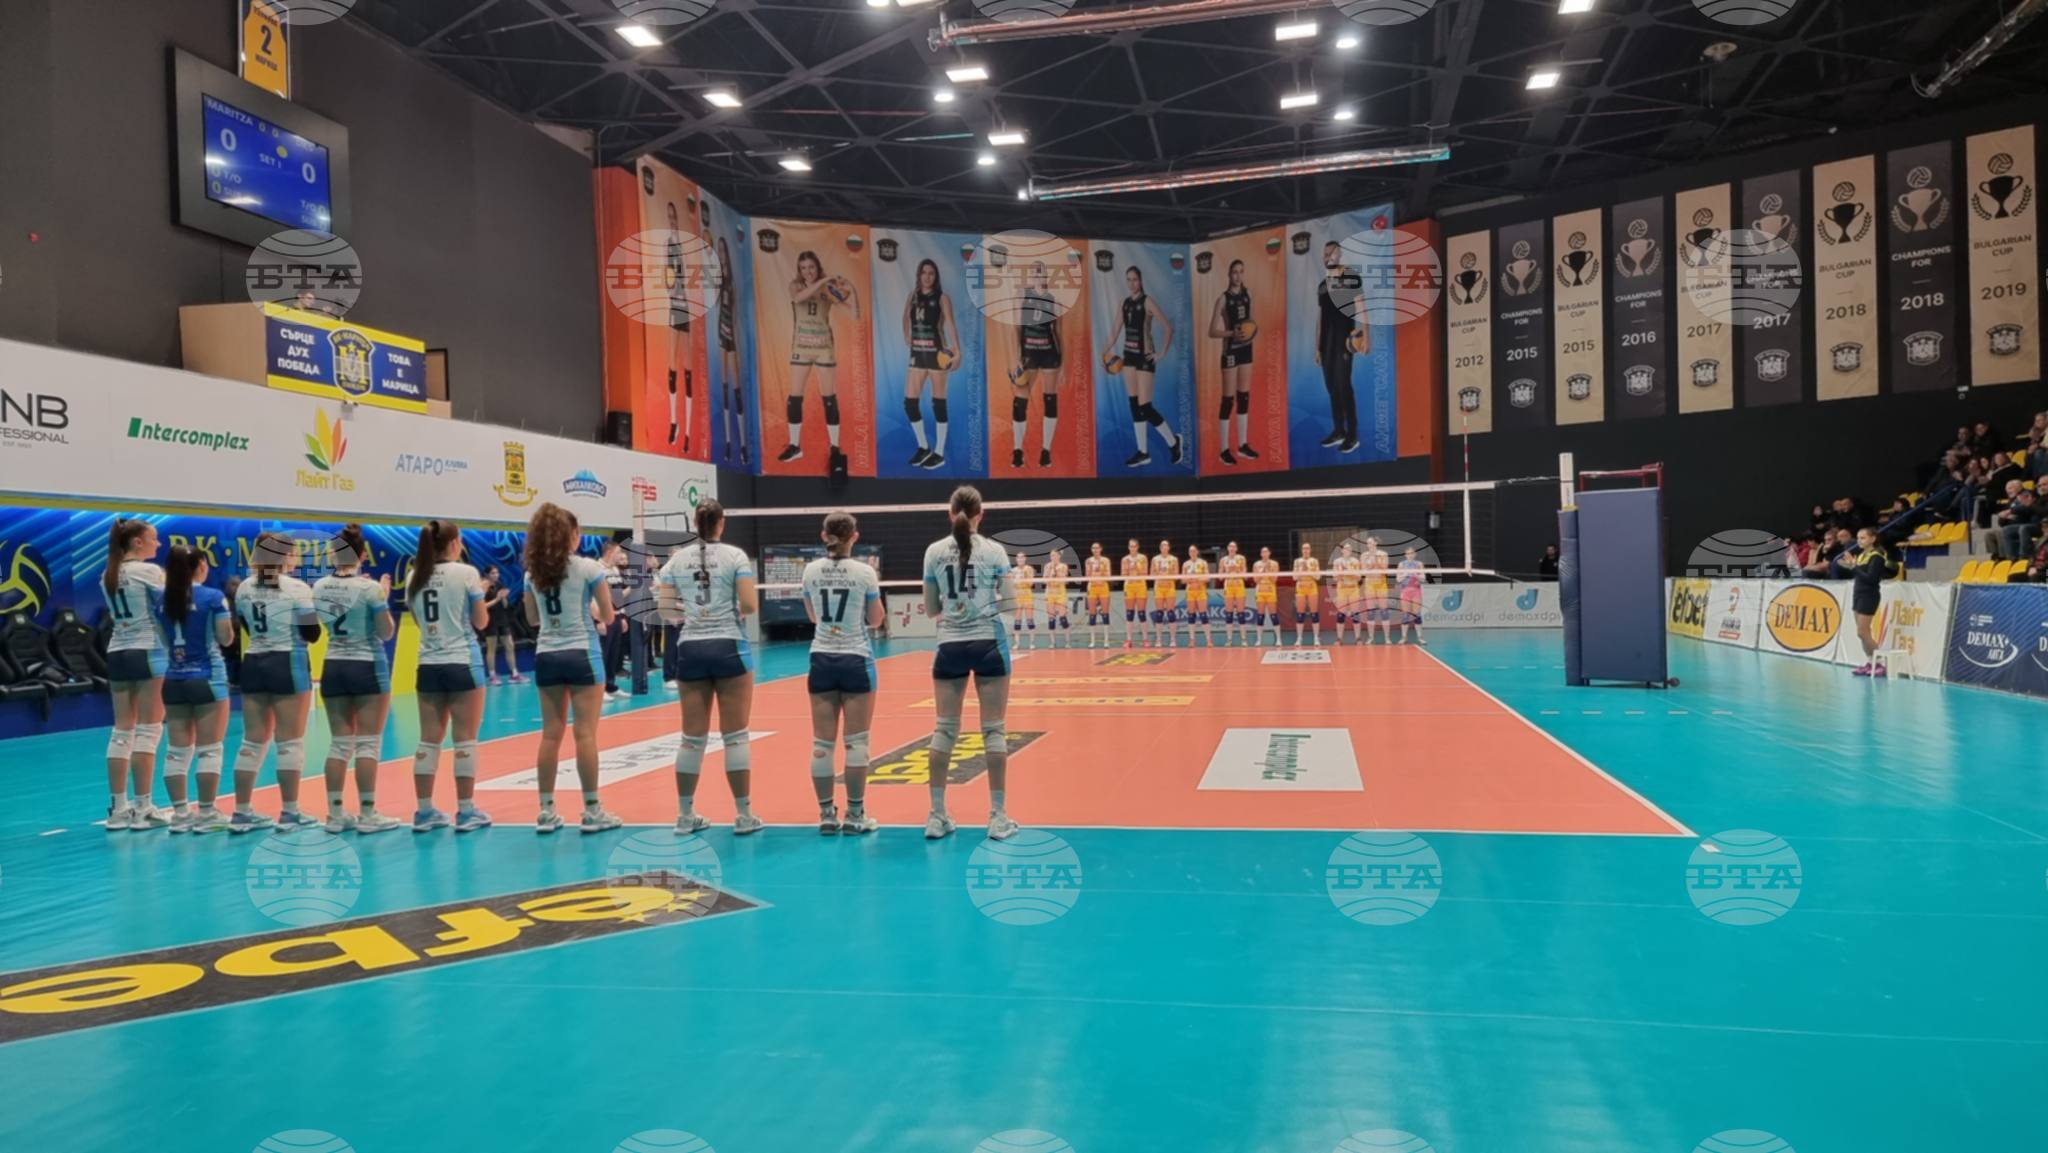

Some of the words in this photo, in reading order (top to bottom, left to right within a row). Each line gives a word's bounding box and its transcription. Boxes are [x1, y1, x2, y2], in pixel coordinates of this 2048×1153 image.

[260, 25, 272, 56] 2
[206, 99, 254, 126] MARITZA
[220, 128, 237, 152] 0
[259, 152, 275, 166] SET
[301, 162, 316, 184] 0
[211, 180, 222, 194] 0
[1974, 234, 2032, 250] BULGARIAN
[1891, 245, 1952, 263] CHAMPIONS
[1991, 247, 2014, 257] CUP
[1819, 258, 1872, 273] BULGARIAN
[1911, 257, 1932, 269] FOR
[1835, 269, 1856, 281] CUP
[1614, 288, 1663, 303] CHAMPIONS
[1695, 290, 1713, 299] CUP
[1981, 282, 2027, 301] 2019
[1557, 300, 1600, 313] BULGARIAN
[1629, 298, 1647, 309] FOR
[1900, 292, 1945, 312] 2018
[1500, 307, 1543, 321] CHAMPIONS
[1570, 308, 1586, 319] CUP
[1825, 303, 1867, 321] 2018
[1450, 316, 1488, 329] BULGARIAN
[1514, 316, 1530, 326] FOR
[1753, 312, 1792, 330] 2017
[280, 327, 315, 346] СЪРЦЕ
[1461, 325, 1477, 335] CUP
[1621, 330, 1657, 347] 2016
[1687, 322, 1723, 338] 2017
[287, 344, 310, 359] ДУХ
[1506, 347, 1538, 362] 2015
[1562, 339, 1595, 355] 2015
[277, 358, 321, 376] ПОБЕДА
[387, 352, 411, 367] ТОВА
[1455, 354, 1484, 368] 2012
[381, 378, 420, 395] МАРИЦА
[0, 427, 70, 445] ESSIONAL
[128, 417, 249, 451] Intercomplex
[295, 469, 331, 490] Лайт
[331, 472, 355, 492] Газ
[236, 536, 378, 568] МРИА
[693, 570, 711, 606] 3
[945, 563, 978, 599] 14
[110, 588, 133, 619] 11
[423, 589, 439, 622] 6
[819, 588, 850, 623] 17
[252, 602, 268, 633] 9
[330, 604, 348, 635] 2
[1423, 611, 1485, 623] demaxdpi
[1774, 602, 1834, 635] DEMAX
[1889, 599, 1925, 628] Лайт
[1892, 628, 1915, 656] Газ
